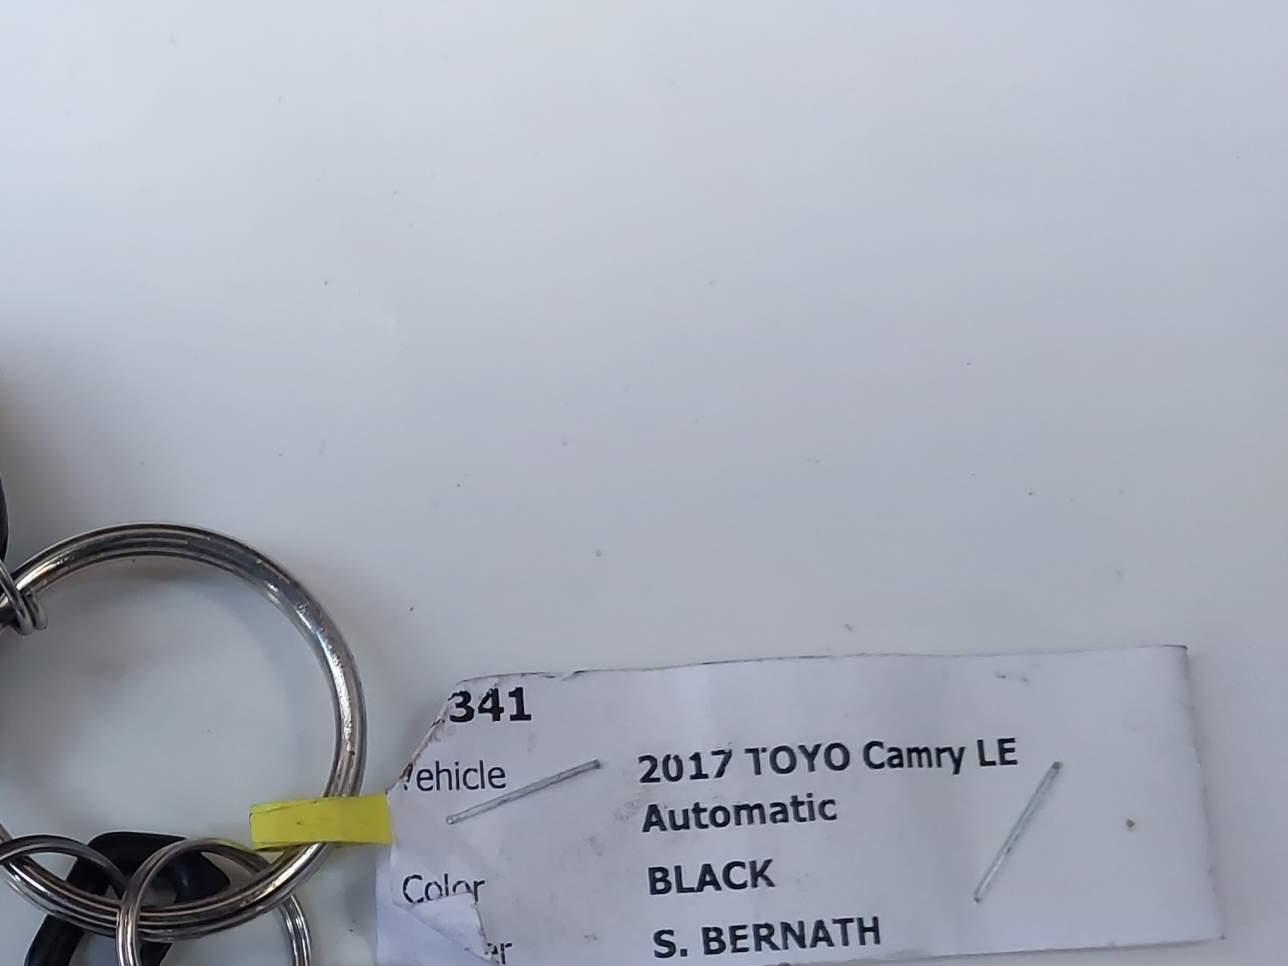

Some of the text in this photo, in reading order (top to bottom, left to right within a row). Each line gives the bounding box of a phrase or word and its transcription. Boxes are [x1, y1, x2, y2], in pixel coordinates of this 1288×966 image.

[638, 737, 1018, 784] 2017 TOYO Camry LE
[641, 792, 838, 833] Automatic
[647, 858, 776, 896] BLACK
[653, 915, 881, 959] S. BERNATH
